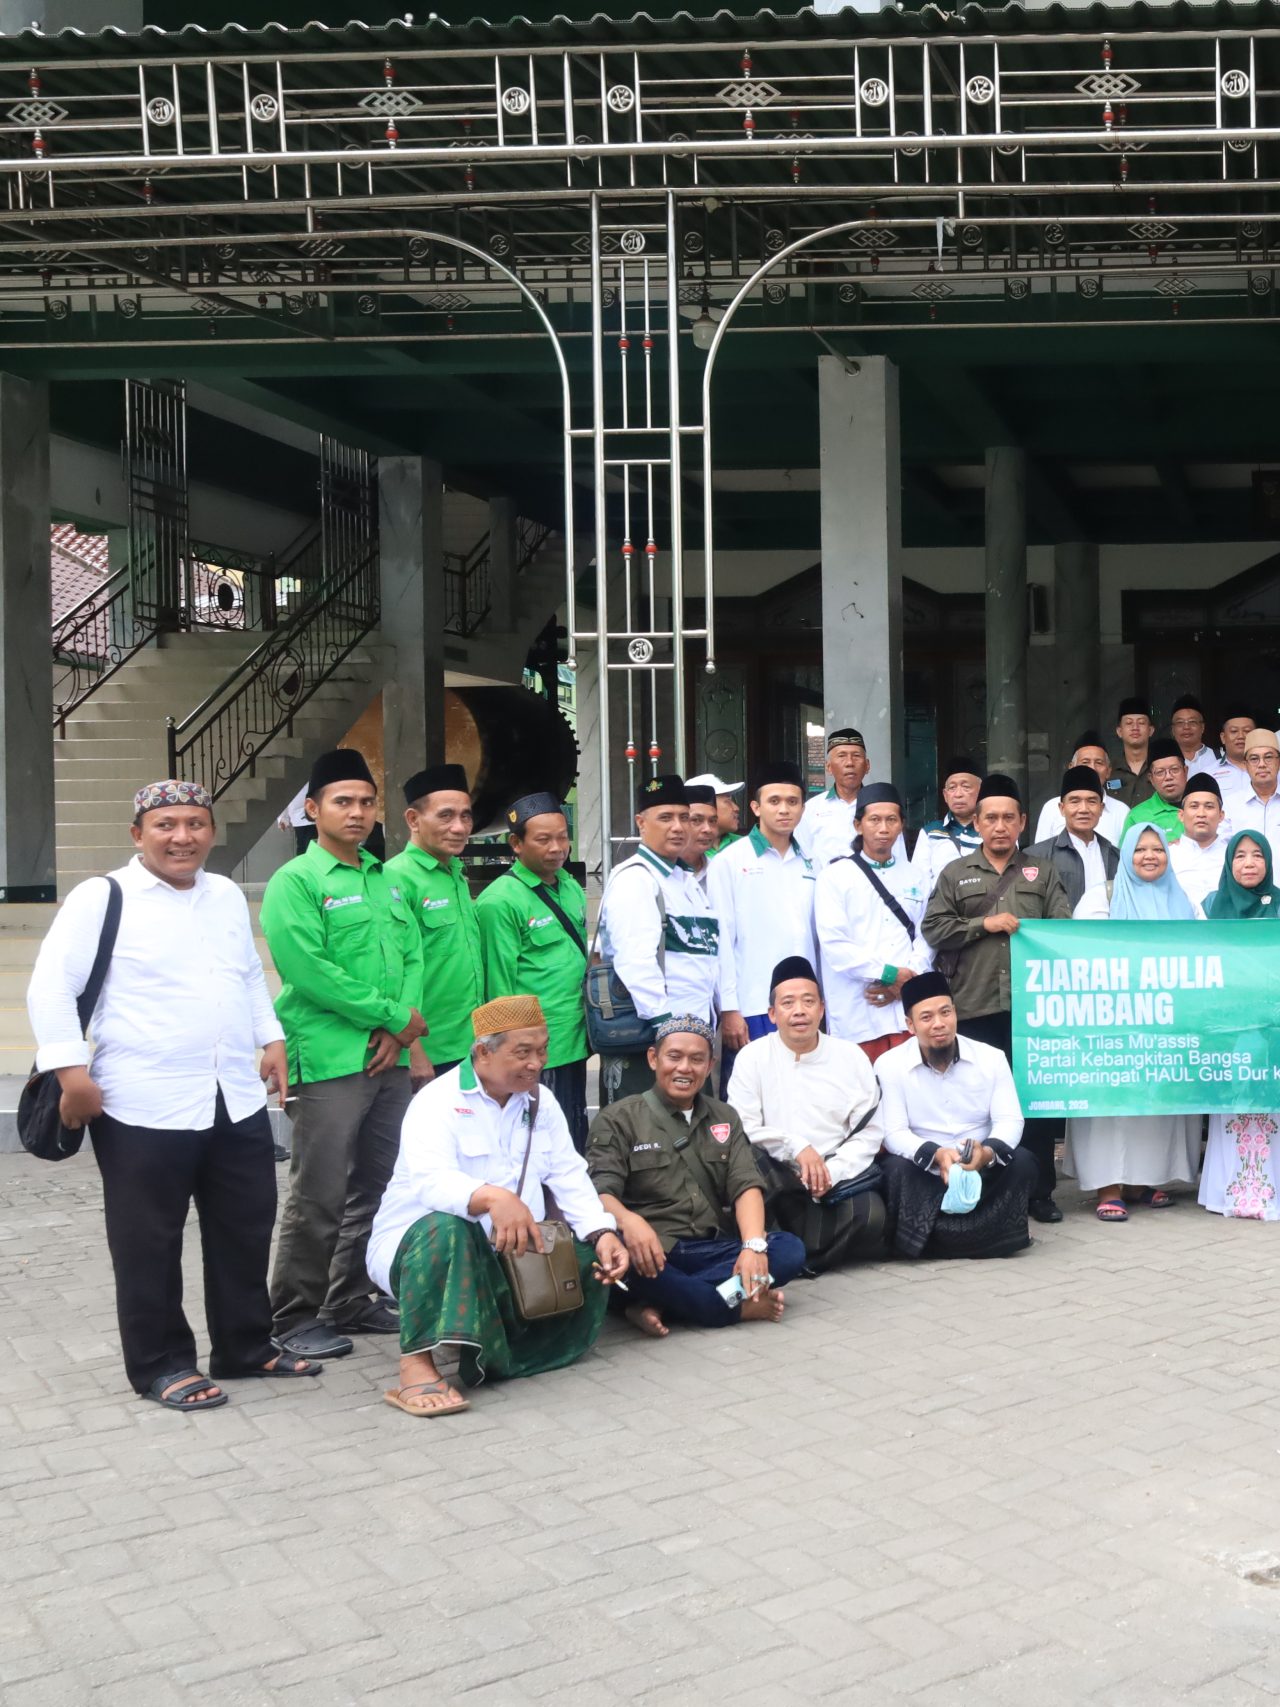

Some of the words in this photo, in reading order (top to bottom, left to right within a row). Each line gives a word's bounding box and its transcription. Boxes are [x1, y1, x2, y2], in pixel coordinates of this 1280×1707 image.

[1026, 958, 1129, 992] ZIARAH
[1140, 956, 1224, 990] AULIA
[1026, 992, 1174, 1027] JOMBANG
[1027, 1036, 1080, 1054] Napak
[1085, 1034, 1124, 1049] Tilas
[1129, 1034, 1200, 1049] Mu'assis
[1027, 1053, 1076, 1068] Partai
[1082, 1051, 1183, 1070] Kebangkitan
[1189, 1050, 1252, 1068] Bangsa
[1027, 1068, 1140, 1086] Memperingati
[1146, 1067, 1194, 1082] HAUL
[1199, 1066, 1232, 1082] Gus
[1239, 1066, 1268, 1080] Dur
[1028, 1100, 1066, 1111] JOMBANG,
[1068, 1100, 1089, 1109] 2025
[634, 1144, 651, 1152] DEDI
